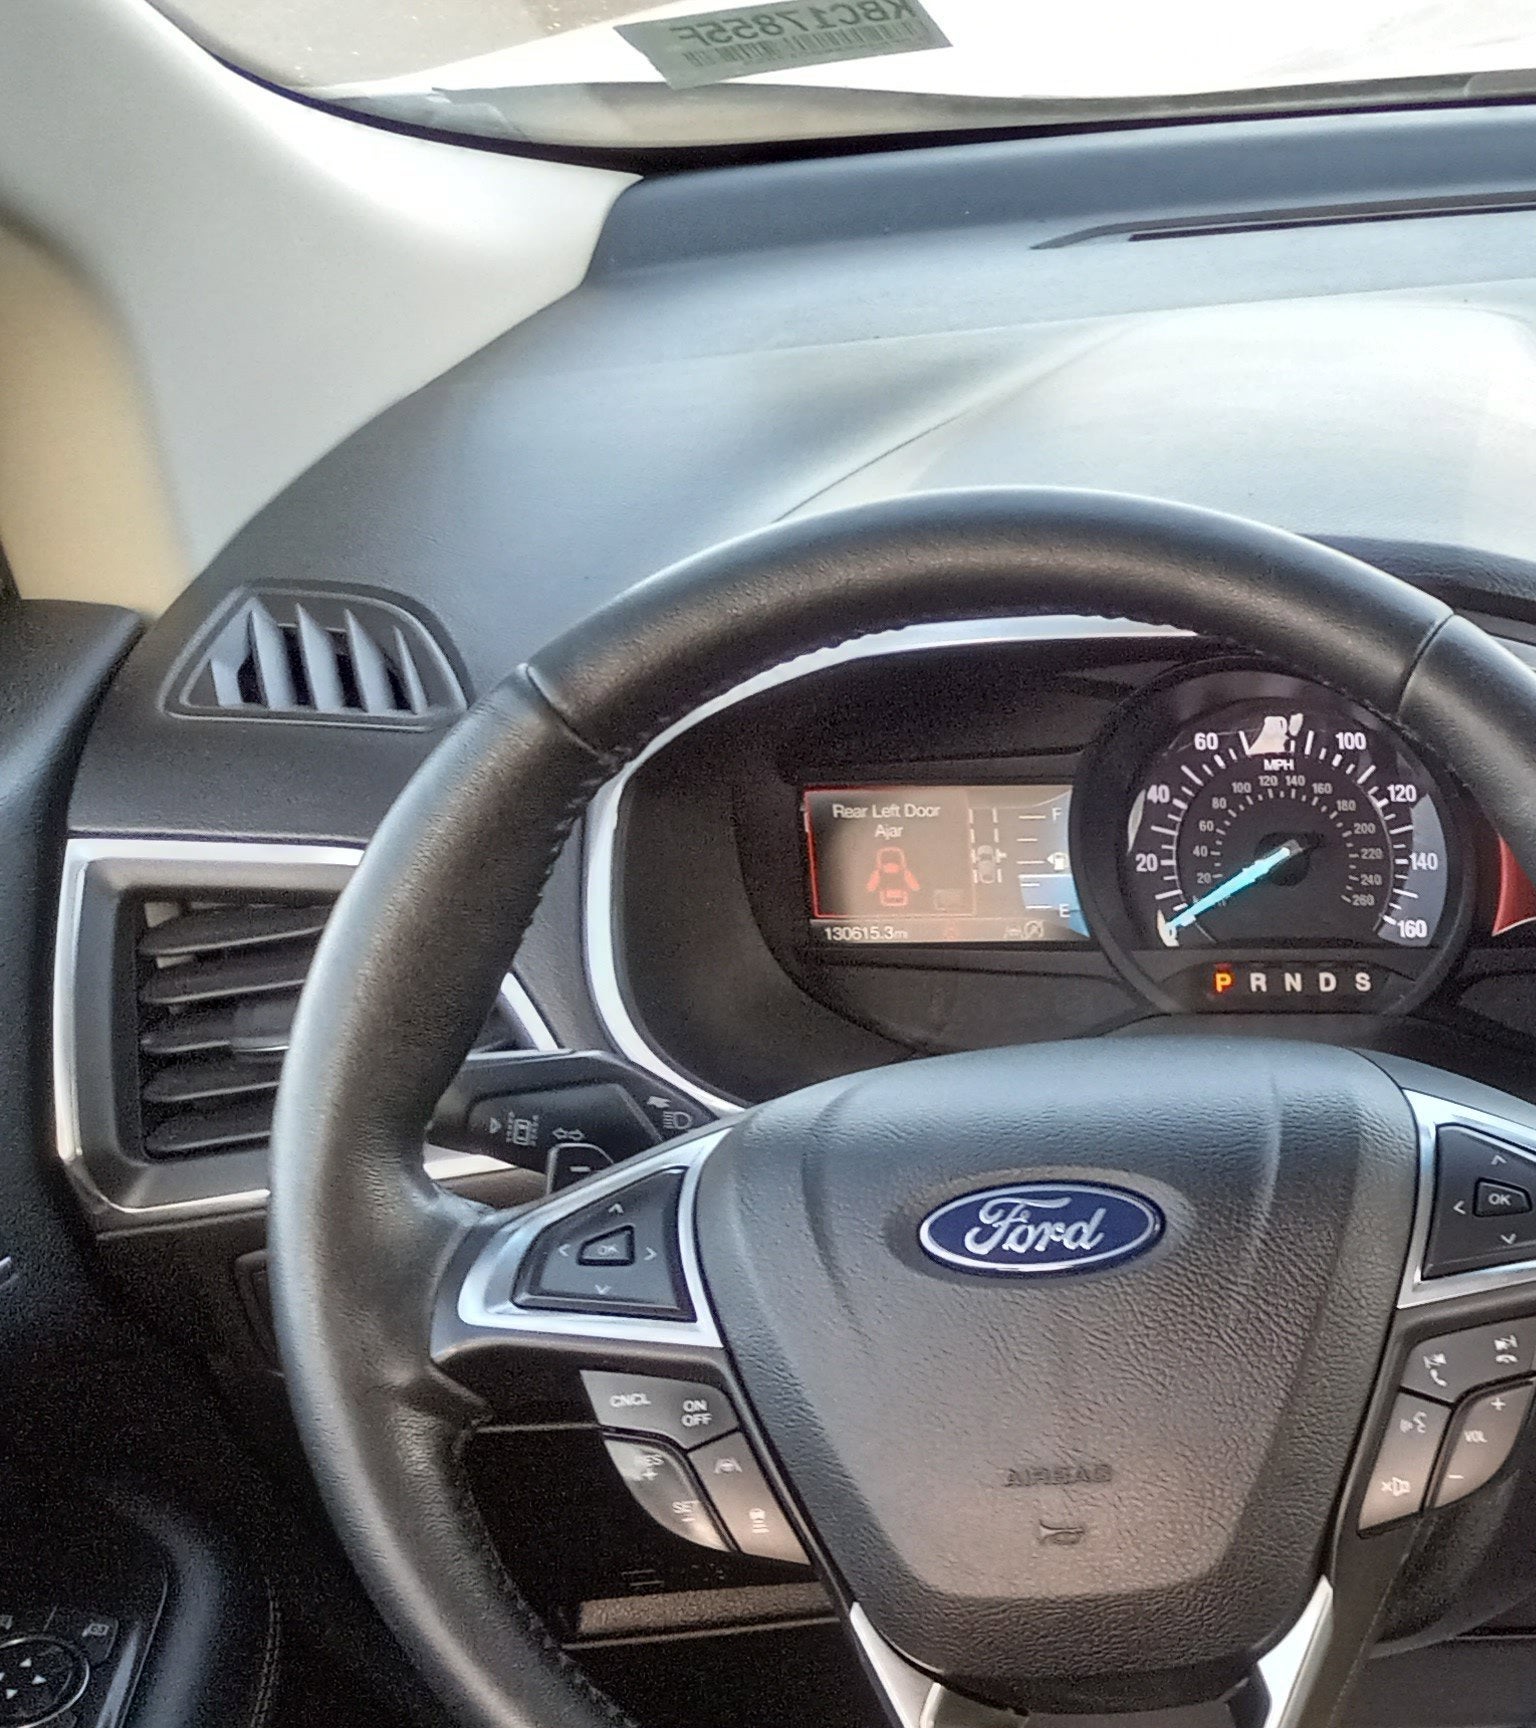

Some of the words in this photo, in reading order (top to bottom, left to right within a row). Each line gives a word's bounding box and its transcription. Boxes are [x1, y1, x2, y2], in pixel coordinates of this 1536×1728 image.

[1195, 732, 1218, 750] 60
[1335, 732, 1367, 750] 100
[1264, 759, 1294, 771] MPH
[1258, 775, 1278, 786] 120
[1285, 775, 1305, 787] 140
[1231, 782, 1251, 793] 100
[1312, 783, 1333, 794] 160
[1387, 784, 1417, 803] 120
[1147, 785, 1170, 803] 40
[1212, 797, 1227, 809] 80
[1336, 800, 1356, 811] 180
[832, 804, 868, 819] Rear
[872, 803, 901, 818] Left
[904, 803, 940, 818] Door
[1052, 808, 1062, 820] F
[875, 824, 903, 839] Ajar
[1199, 820, 1214, 832] 60
[1354, 823, 1376, 834] 200
[1193, 846, 1208, 857] 40
[1361, 848, 1383, 860] 220
[1136, 853, 1158, 872] 20
[1409, 852, 1439, 870] 140
[1196, 872, 1211, 884] 20
[1360, 874, 1382, 886] 240
[1398, 919, 1428, 938] 160
[1215, 973, 1233, 992] P
[1250, 973, 1268, 992] R
[1285, 973, 1302, 992] N
[1319, 973, 1337, 992] D
[1355, 972, 1371, 992] S
[1488, 1193, 1511, 1206] OK
[965, 1196, 1106, 1255] Ford
[610, 1392, 651, 1408] CNCL
[683, 1400, 707, 1412] ON
[681, 1413, 712, 1427] OFF
